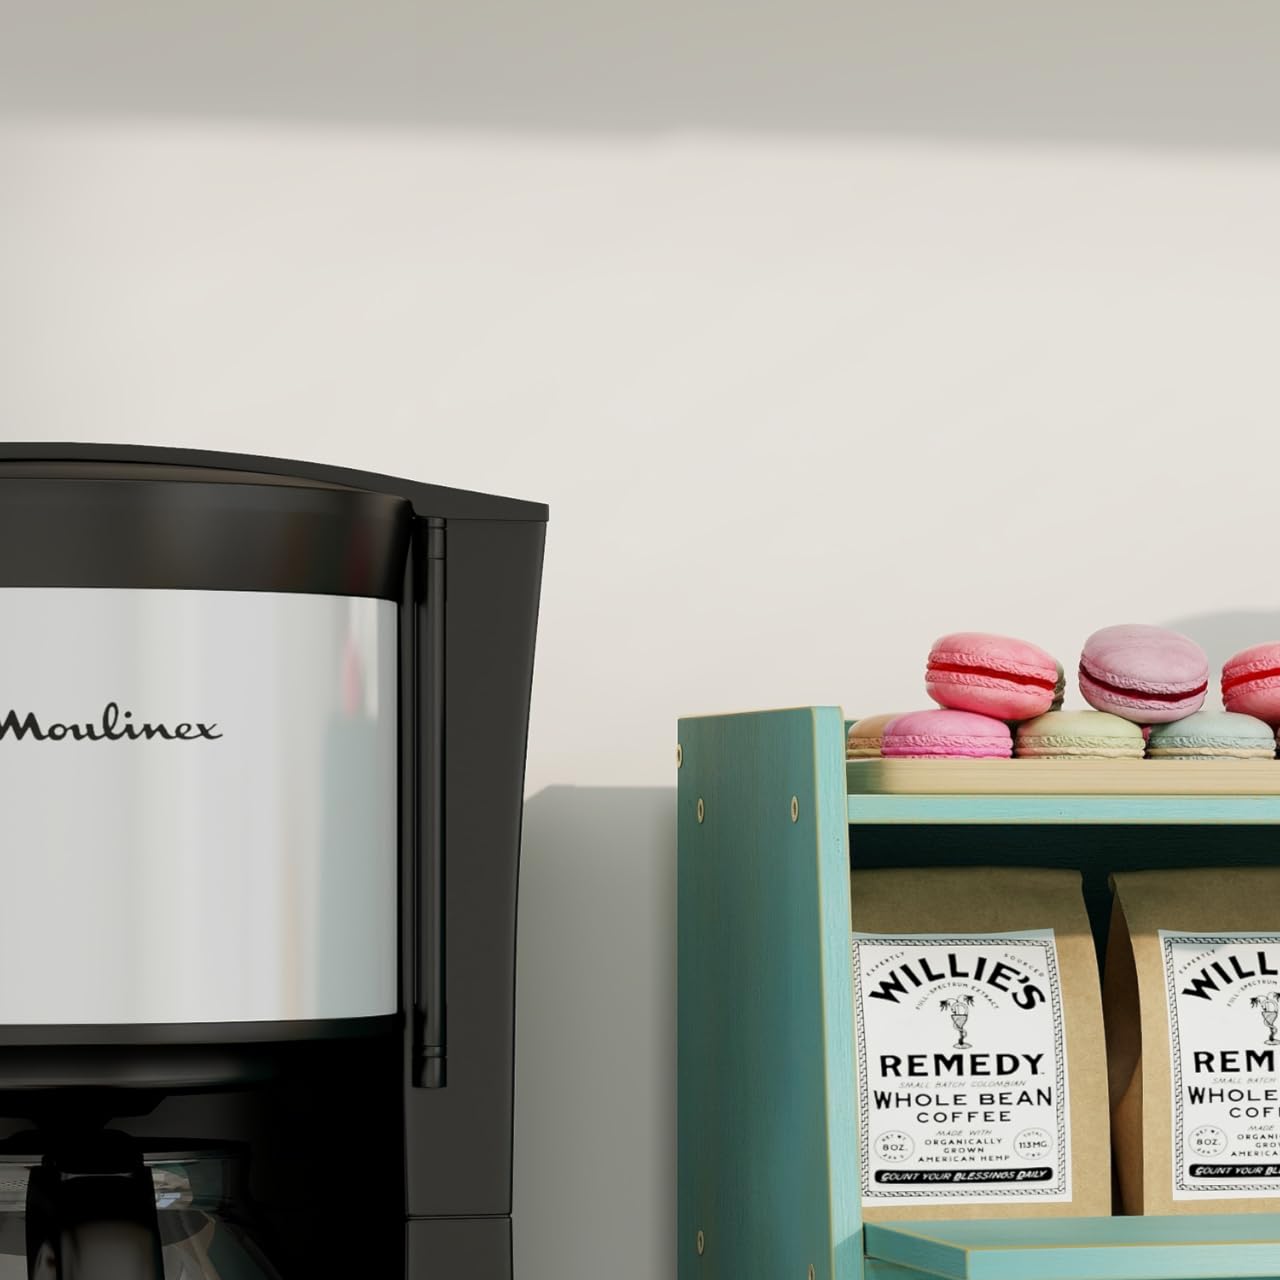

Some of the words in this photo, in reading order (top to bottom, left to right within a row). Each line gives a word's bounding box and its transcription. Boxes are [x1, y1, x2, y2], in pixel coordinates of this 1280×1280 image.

[0, 702, 223, 741] Moulinex
[868, 953, 1046, 1010] WILLIE'S
[880, 1054, 1044, 1077] REMEDY
[900, 1081, 929, 1089] SMALL
[874, 1090, 967, 1110] WHOLE
[979, 1086, 1052, 1106] BEAN
[1188, 1086, 1278, 1105] WHOLE
[916, 1111, 1011, 1123] COFFEE
[925, 1138, 1002, 1146] ORGANICALLY
[881, 1172, 917, 1182] COUNT
[923, 1173, 952, 1181] YOUR
[953, 1171, 1015, 1182] BLESSINGS
[1016, 1170, 1048, 1180] DAILY
[1195, 1166, 1232, 1176] COUNT
[1236, 1167, 1263, 1175] YOUR
